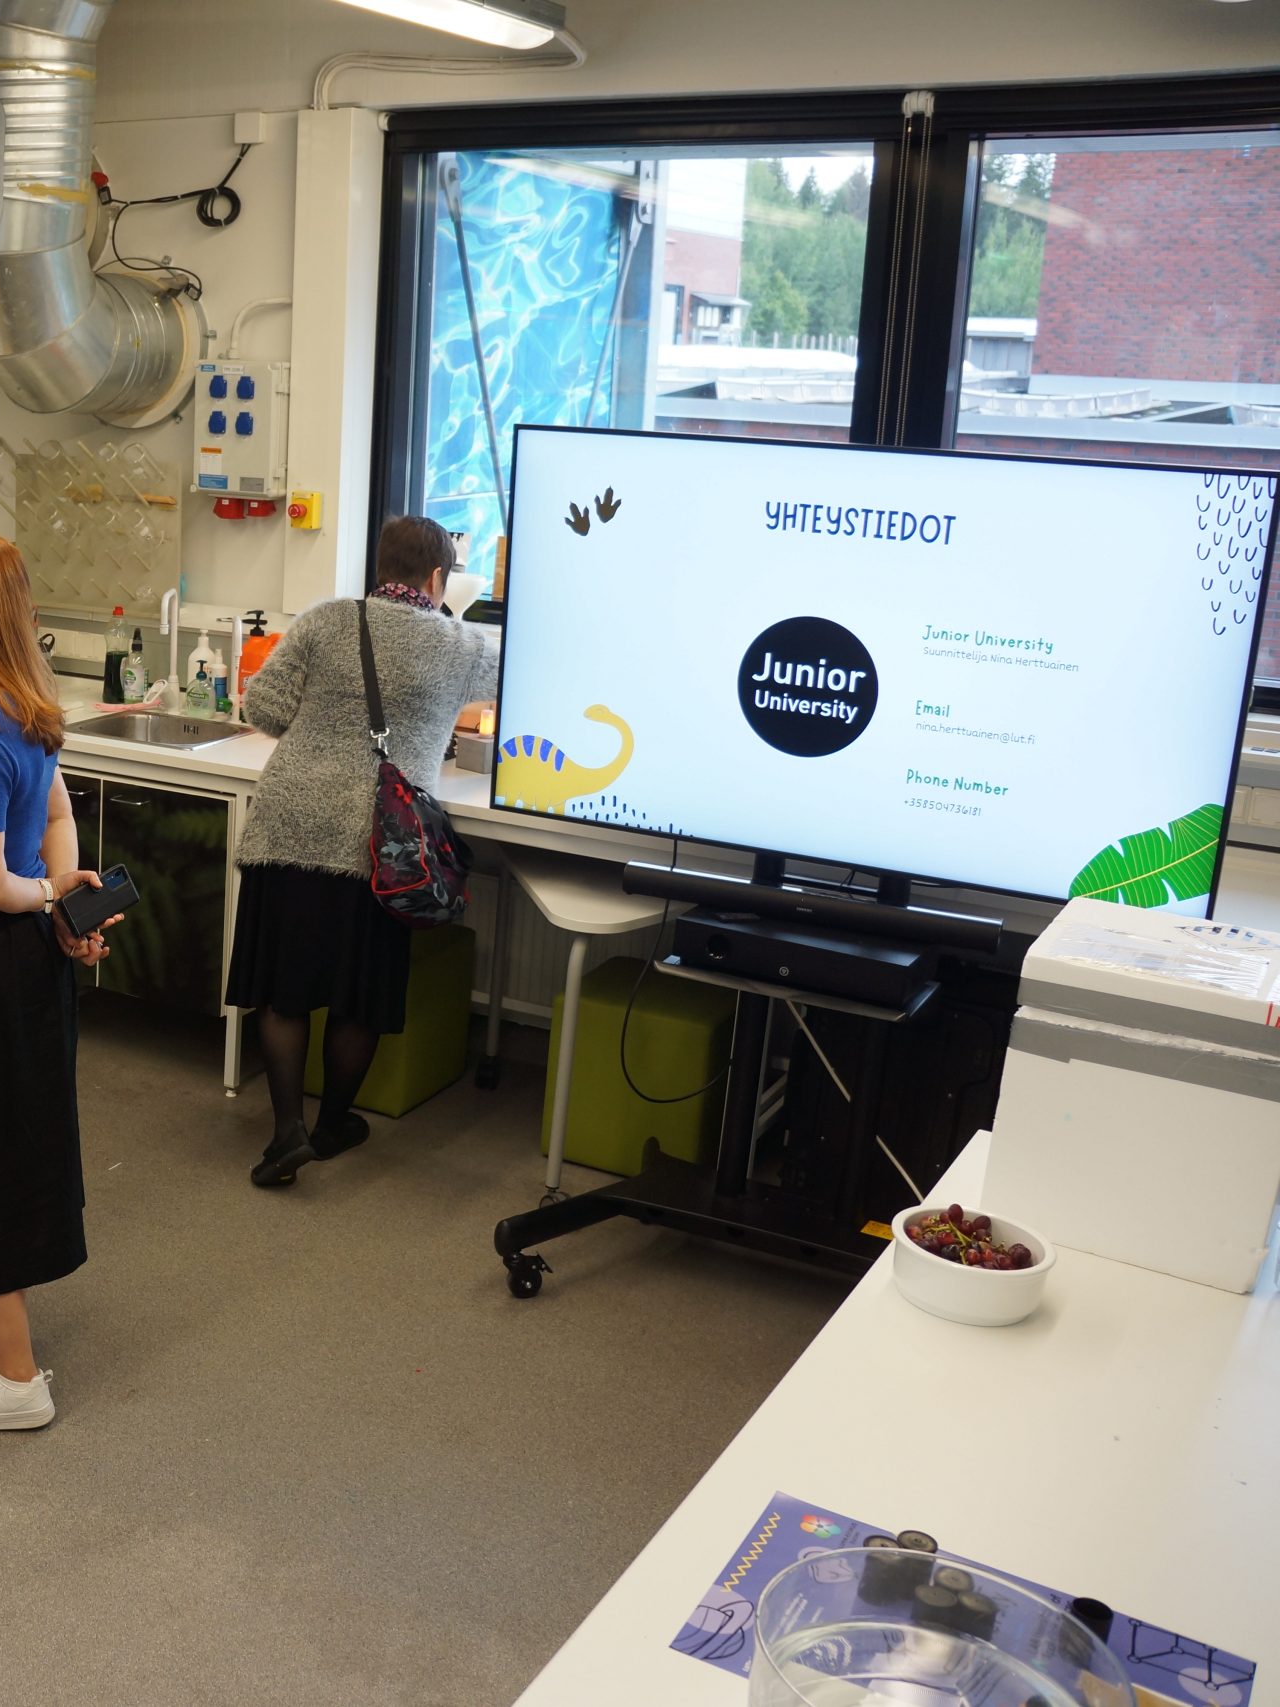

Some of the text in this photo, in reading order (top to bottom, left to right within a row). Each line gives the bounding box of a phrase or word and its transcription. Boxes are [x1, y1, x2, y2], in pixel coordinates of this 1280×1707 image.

[765, 501, 956, 545] YHTEYSTIEDOT
[922, 625, 1054, 654] Junior University
[751, 652, 867, 693] Junior
[923, 646, 1079, 672] Suunnittelija Nina Herttuainen
[754, 689, 859, 724] University
[916, 700, 950, 718] Email
[916, 721, 1036, 745] nina.herttuainen@lut.fi
[906, 769, 1009, 796] Phone Number
[904, 798, 982, 817] +358504736181
